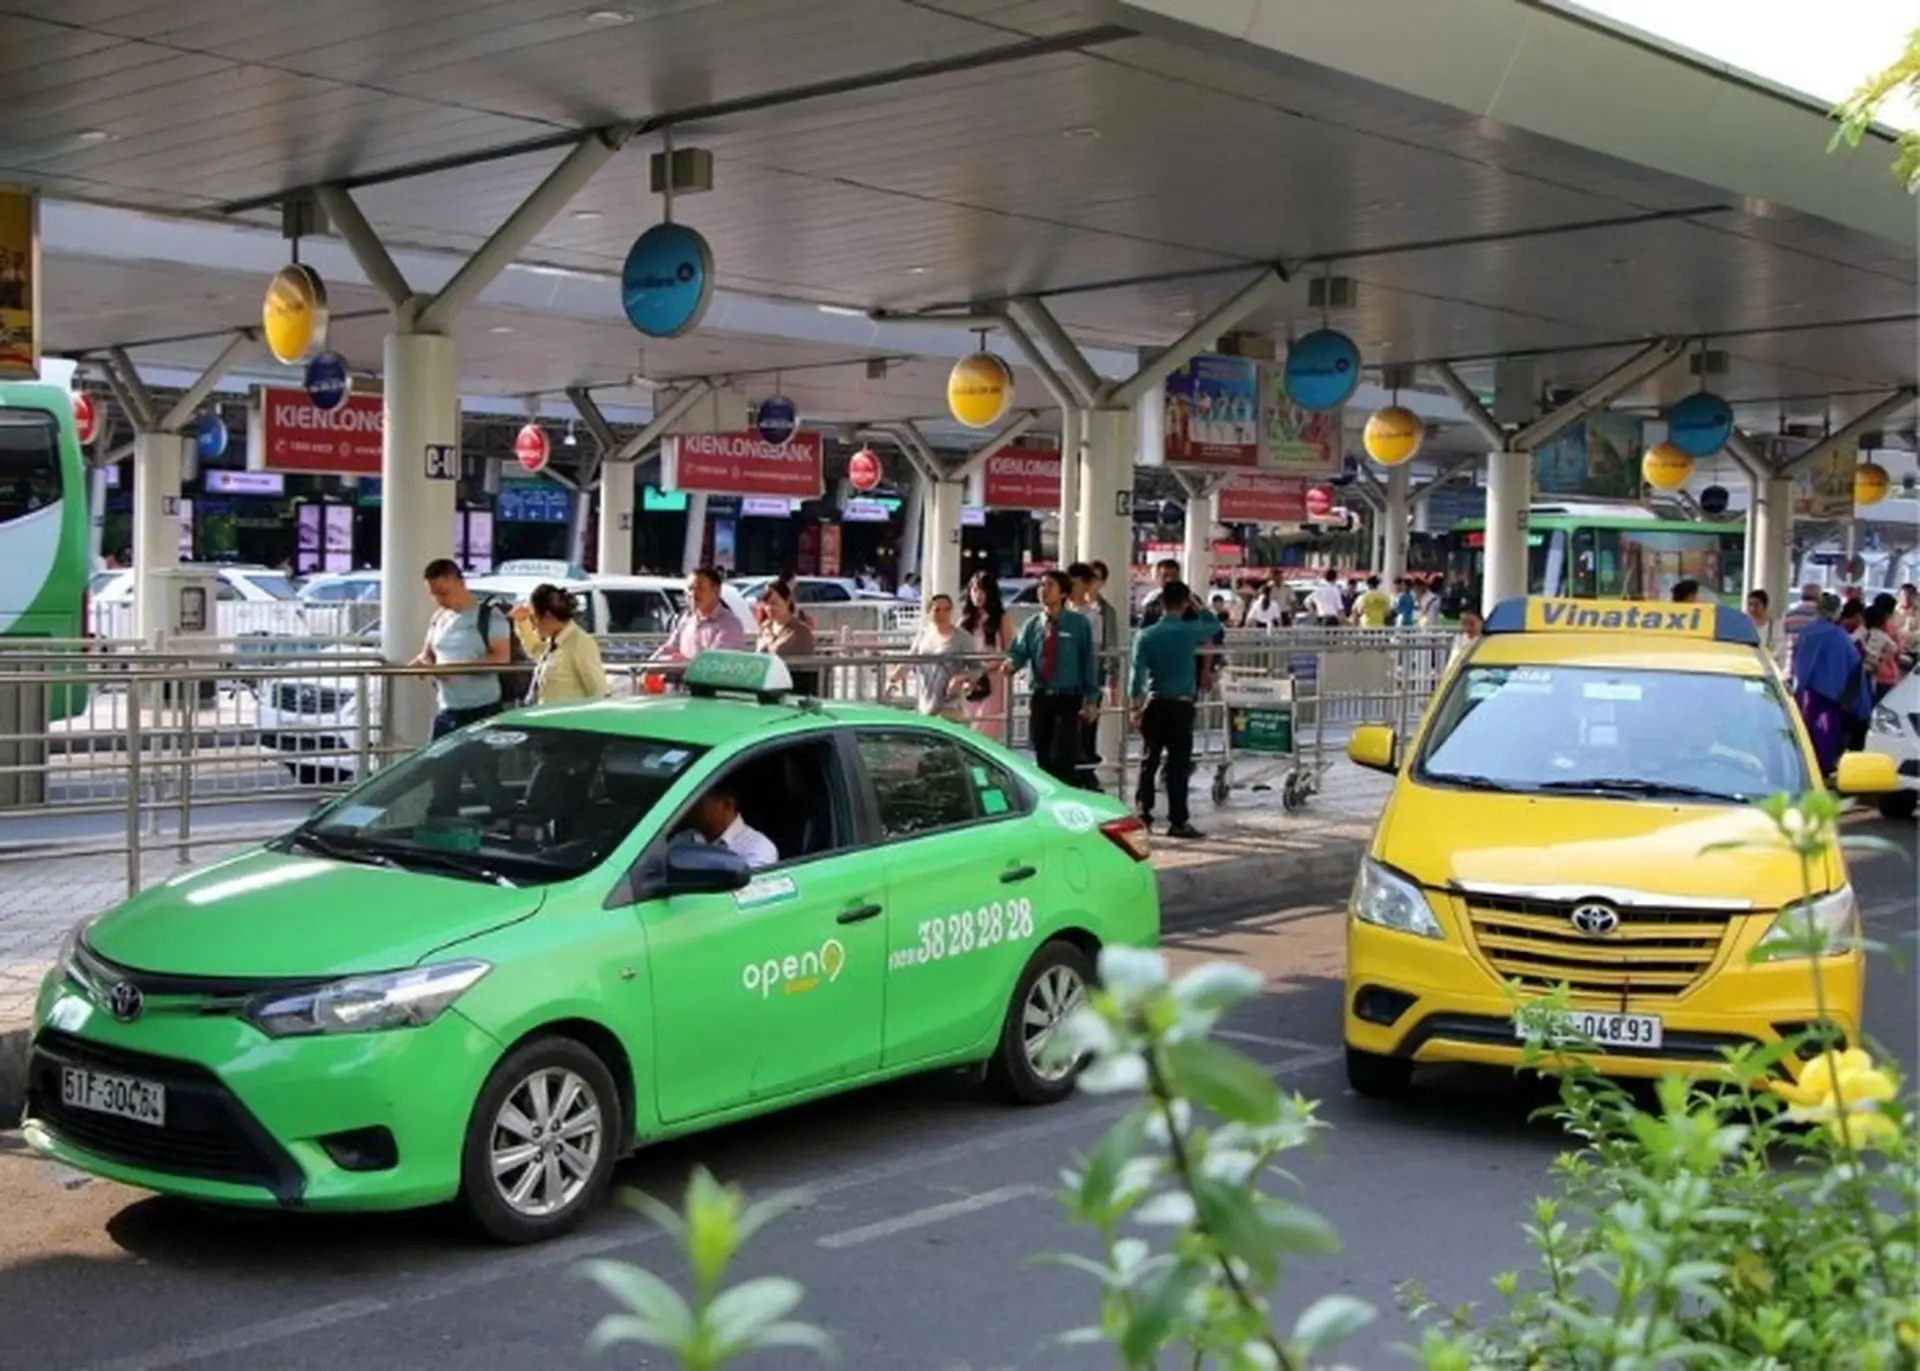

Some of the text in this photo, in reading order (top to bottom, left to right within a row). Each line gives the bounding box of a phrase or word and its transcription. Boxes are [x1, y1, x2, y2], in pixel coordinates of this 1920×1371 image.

[684, 434, 814, 463] KIENLONGBANK
[1543, 602, 1702, 631] Vinataxi
[918, 918, 945, 964] 38
[948, 912, 975, 956] 28
[977, 900, 1003, 949] 28
[1005, 896, 1034, 941] 28
